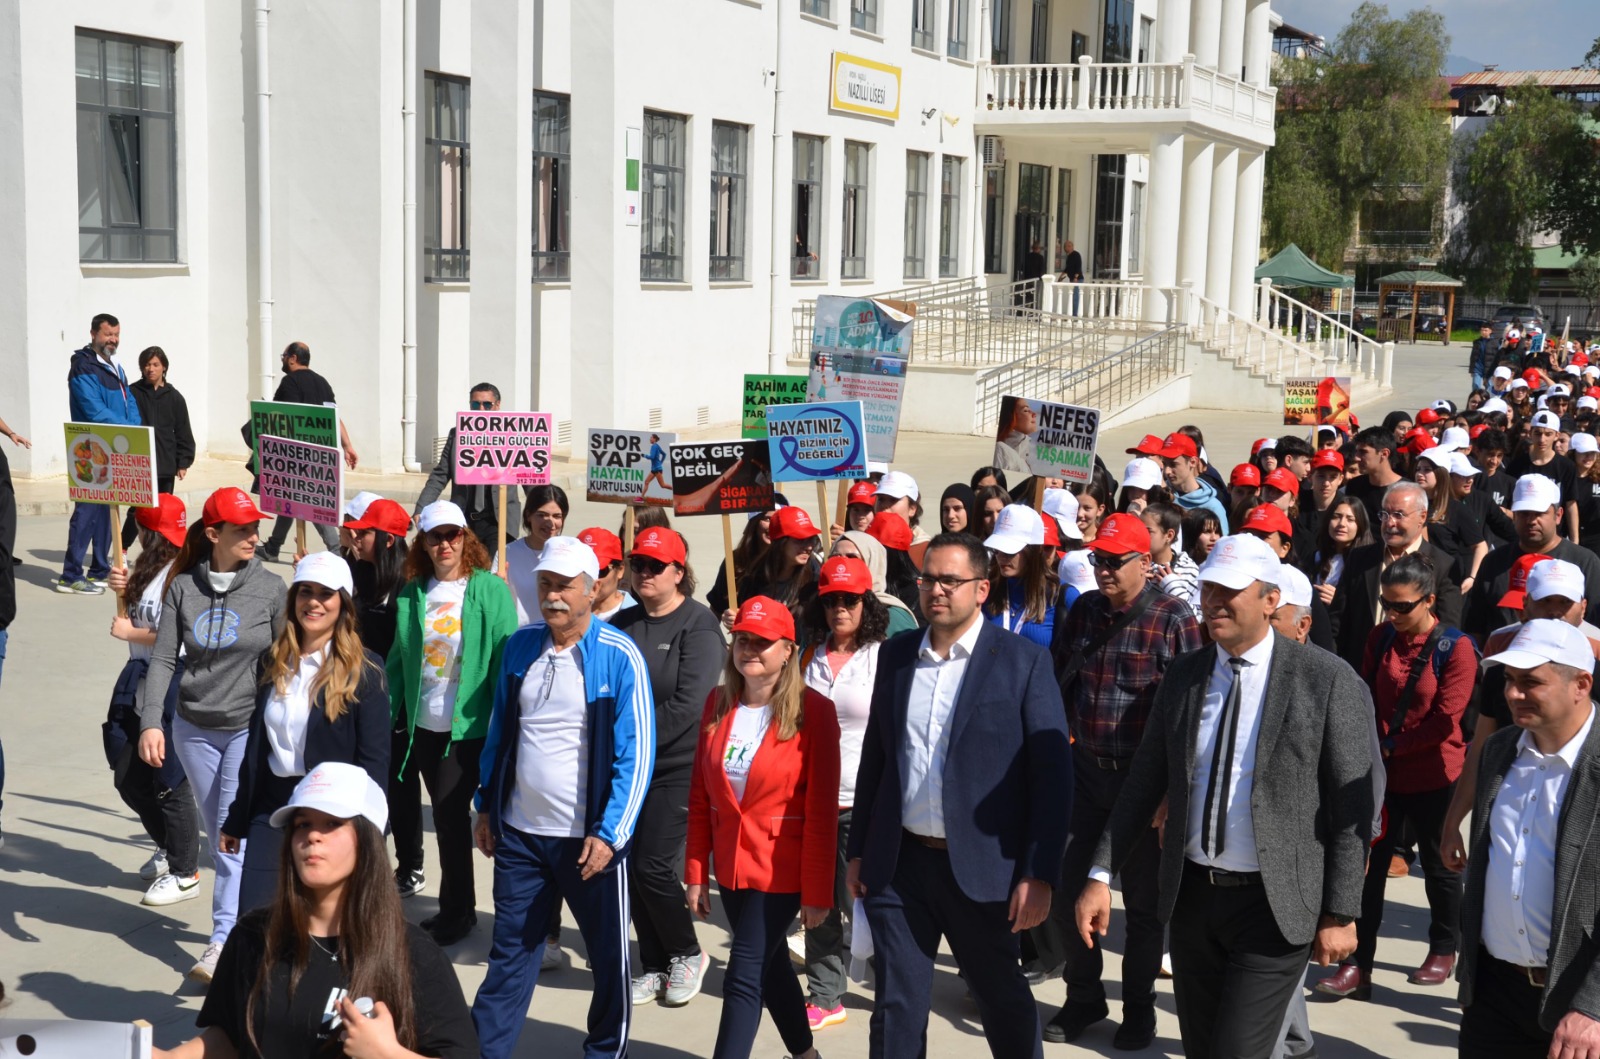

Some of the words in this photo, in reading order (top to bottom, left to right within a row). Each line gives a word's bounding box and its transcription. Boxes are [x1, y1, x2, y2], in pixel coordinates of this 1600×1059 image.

[848, 81, 869, 101] NAZİLLİ
[870, 83, 886, 104] LİSESİ
[746, 379, 787, 392] RAHİM
[791, 380, 807, 393] AĞ
[1286, 389, 1319, 397] YAŞAM
[745, 396, 806, 406] KANSE
[295, 415, 333, 430] TANI
[745, 410, 766, 418] TAR
[1039, 404, 1097, 435] NEFES
[254, 412, 295, 439] ERKEN
[460, 416, 548, 432] KORKMA
[769, 418, 842, 437] HAYATINIZ
[460, 433, 505, 446] BİLGİLEN
[508, 435, 549, 448] GÜÇLEN
[590, 433, 641, 452] SPOR
[799, 437, 827, 448] BİZİM
[829, 436, 849, 448] İÇİN
[1037, 429, 1093, 451] ALMAKTIR
[262, 439, 336, 466] KANSERDEN
[459, 448, 549, 473] SAVAŞ
[590, 450, 642, 468] YAP
[671, 447, 707, 463] ÇOK
[711, 445, 744, 460] GEÇ
[798, 448, 844, 459] DEĞERLİ
[1036, 445, 1091, 468] YAŞAMAK
[263, 456, 336, 483] KORKMA
[590, 466, 644, 481] HAYATIN
[674, 461, 721, 478] DEĞİL
[113, 477, 152, 492] HAYATIN
[263, 472, 336, 498] TANIRSAN
[589, 480, 643, 493] KURTULSUN
[69, 487, 116, 502] MUTLULUK
[118, 491, 153, 504] DOLSUN
[264, 486, 336, 510] YENERSİN
